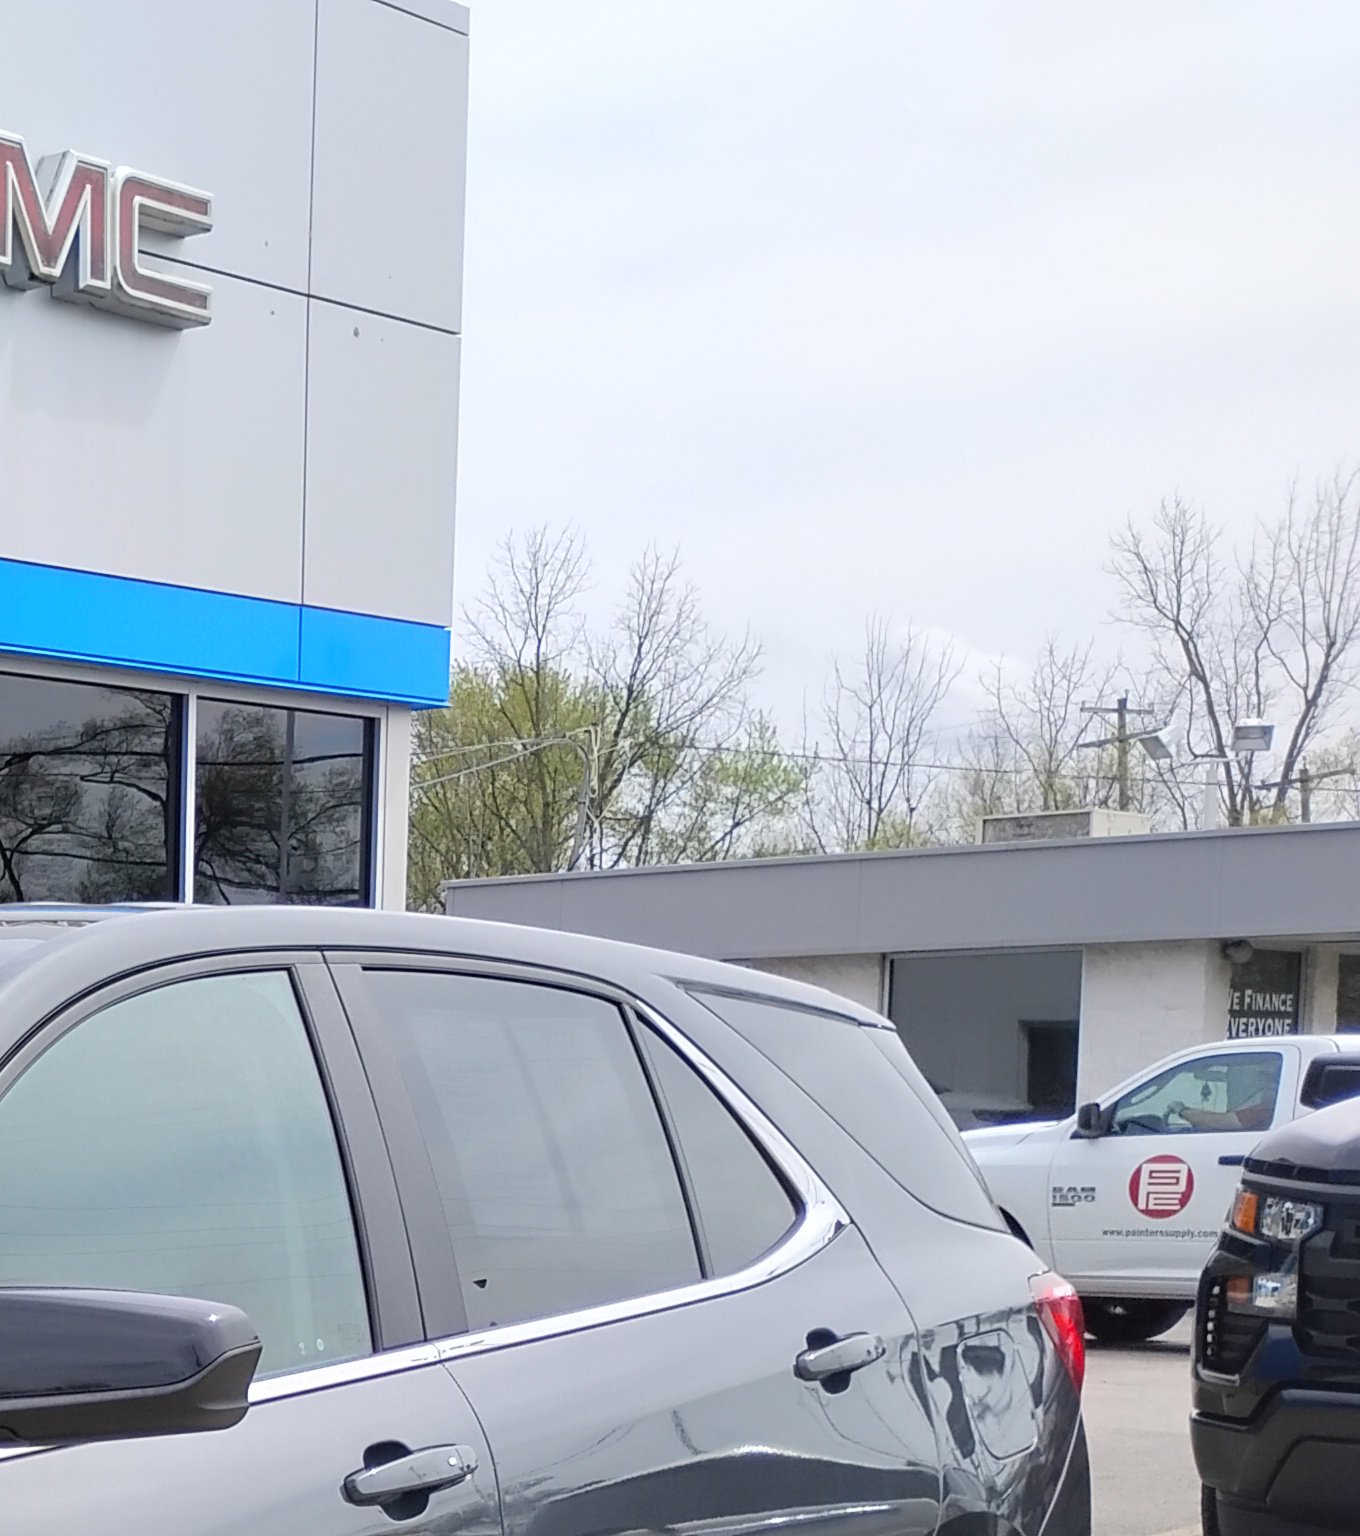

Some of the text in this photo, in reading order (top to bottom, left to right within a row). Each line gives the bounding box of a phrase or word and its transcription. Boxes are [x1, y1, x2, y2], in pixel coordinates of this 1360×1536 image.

[1228, 988, 1293, 1012] E FINANCE
[1227, 1014, 1292, 1038] VERYONE
[1052, 1194, 1096, 1203] 1500
[1101, 1228, 1218, 1239] www.painterssupply.com
